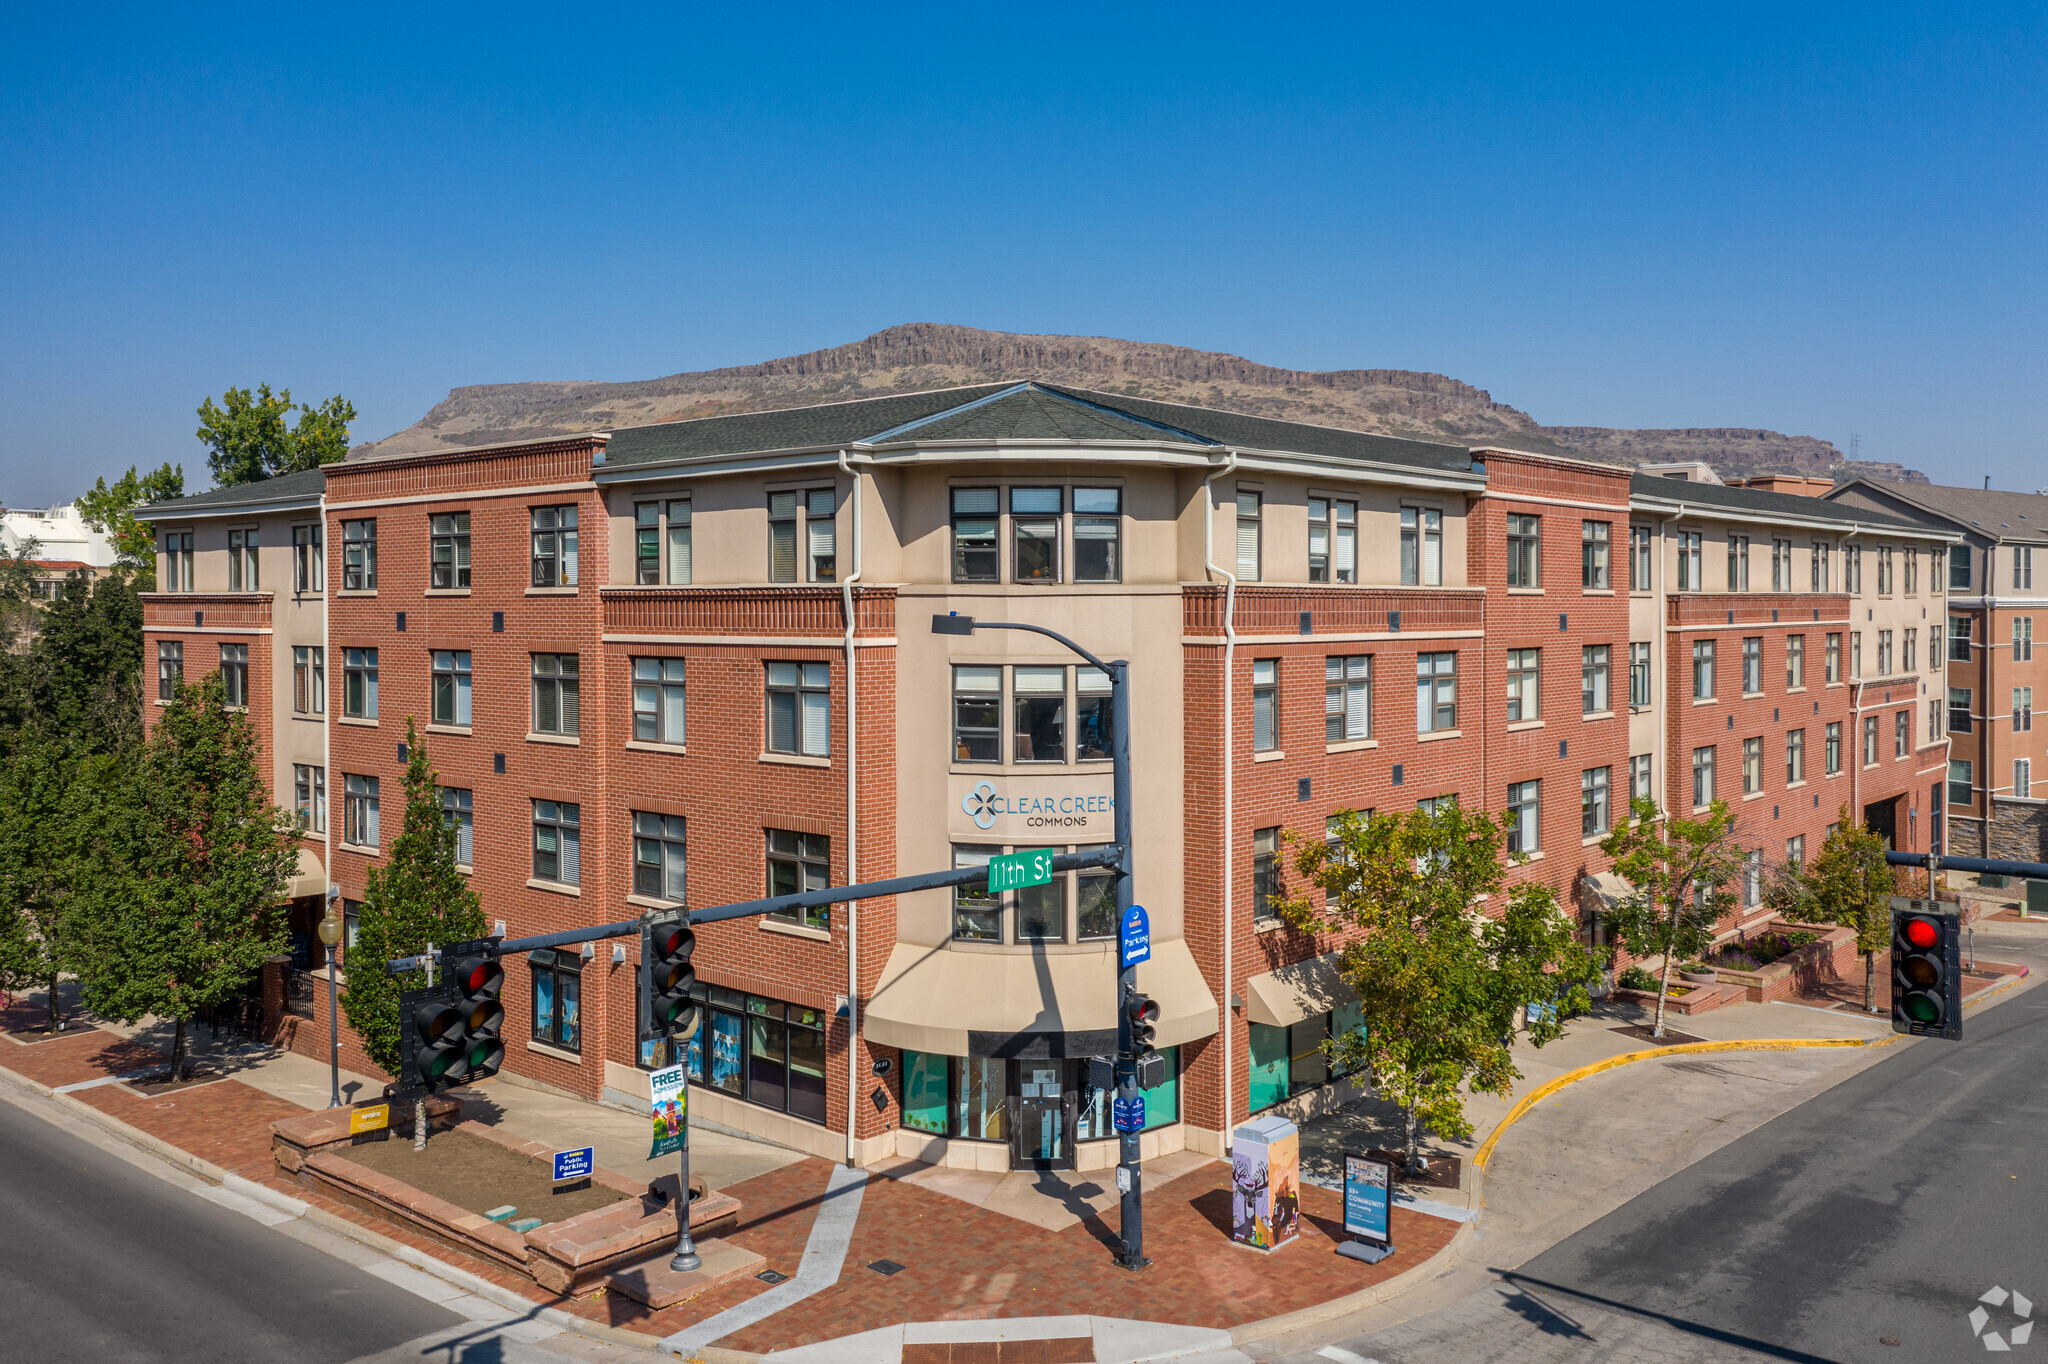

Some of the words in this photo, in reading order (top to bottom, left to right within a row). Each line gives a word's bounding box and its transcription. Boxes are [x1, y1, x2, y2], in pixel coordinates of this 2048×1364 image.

[992, 797, 1056, 814] CLEAR
[1027, 817, 1087, 827] COMMONS
[993, 859, 1025, 887] 11th
[1033, 855, 1051, 881] St
[1124, 935, 1148, 948] Parking
[652, 1069, 682, 1088] FREE
[654, 1082, 684, 1094] ADMISSION
[560, 1162, 587, 1171] Parking
[1348, 1195, 1385, 1208] COMMUNITY
